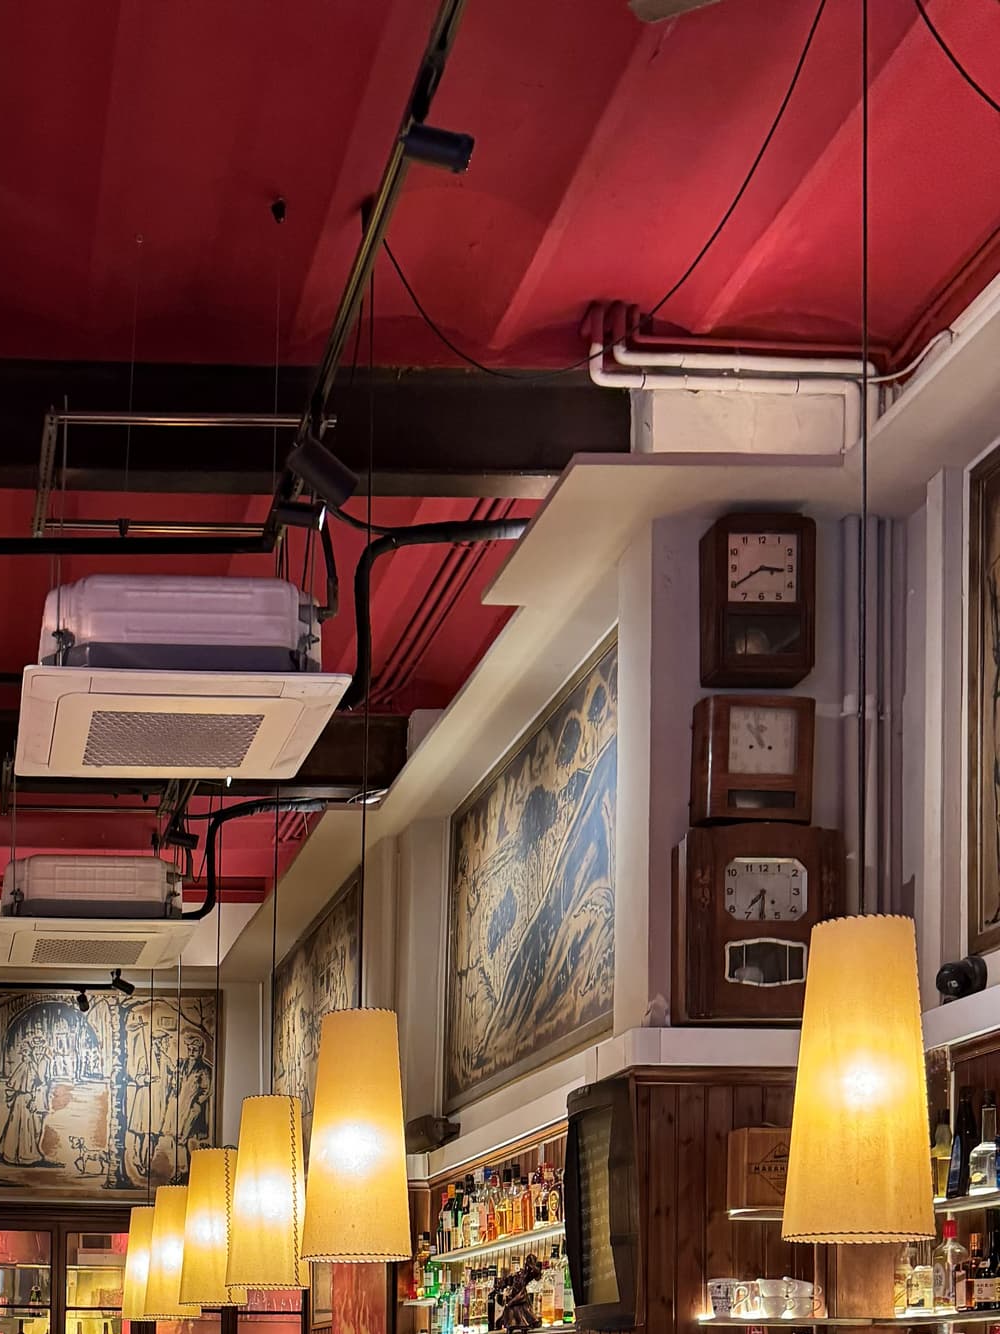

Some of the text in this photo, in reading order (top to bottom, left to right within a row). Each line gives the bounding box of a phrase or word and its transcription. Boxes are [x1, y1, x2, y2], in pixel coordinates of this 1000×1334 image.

[742, 536, 748, 545] 11
[758, 536, 766, 545] 12
[730, 548, 738, 556] 10
[787, 548, 793, 556] 2
[731, 564, 737, 573] 9
[787, 564, 793, 573] 3
[787, 581, 794, 589] 4
[741, 593, 782, 601] 7 6 5
[745, 864, 752, 872] 11
[759, 864, 769, 873] 12
[727, 869, 737, 877] 10
[791, 869, 798, 877] 2
[727, 887, 734, 895] 9
[792, 888, 800, 896] 3
[729, 905, 736, 913] 8
[790, 905, 797, 913] 4
[745, 911, 752, 919] 7
[774, 911, 781, 919] 5
